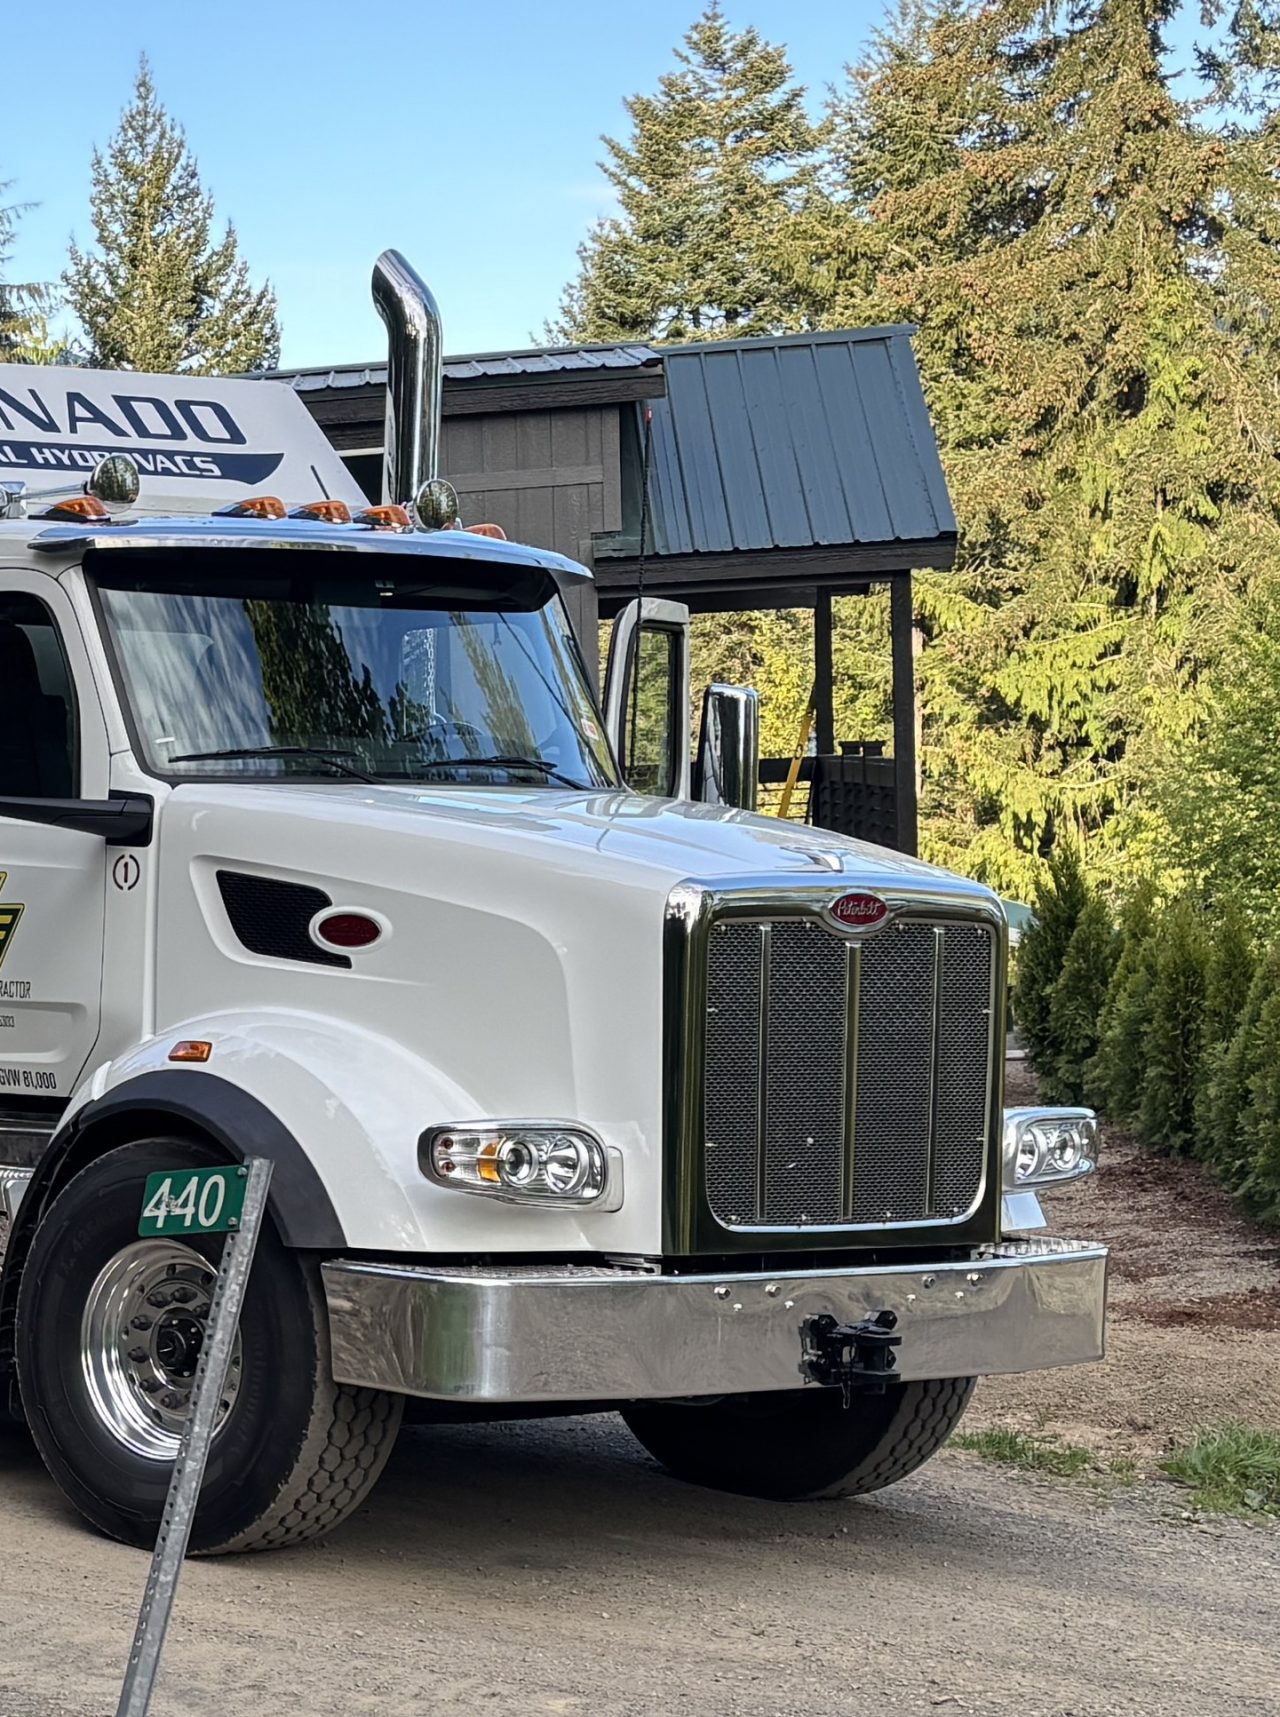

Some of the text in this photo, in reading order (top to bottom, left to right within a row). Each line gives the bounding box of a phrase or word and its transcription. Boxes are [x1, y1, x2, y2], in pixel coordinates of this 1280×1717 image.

[30, 447, 222, 476] HYDVACS
[22, 1070, 57, 1090] 81,000
[142, 1174, 226, 1228] 440
